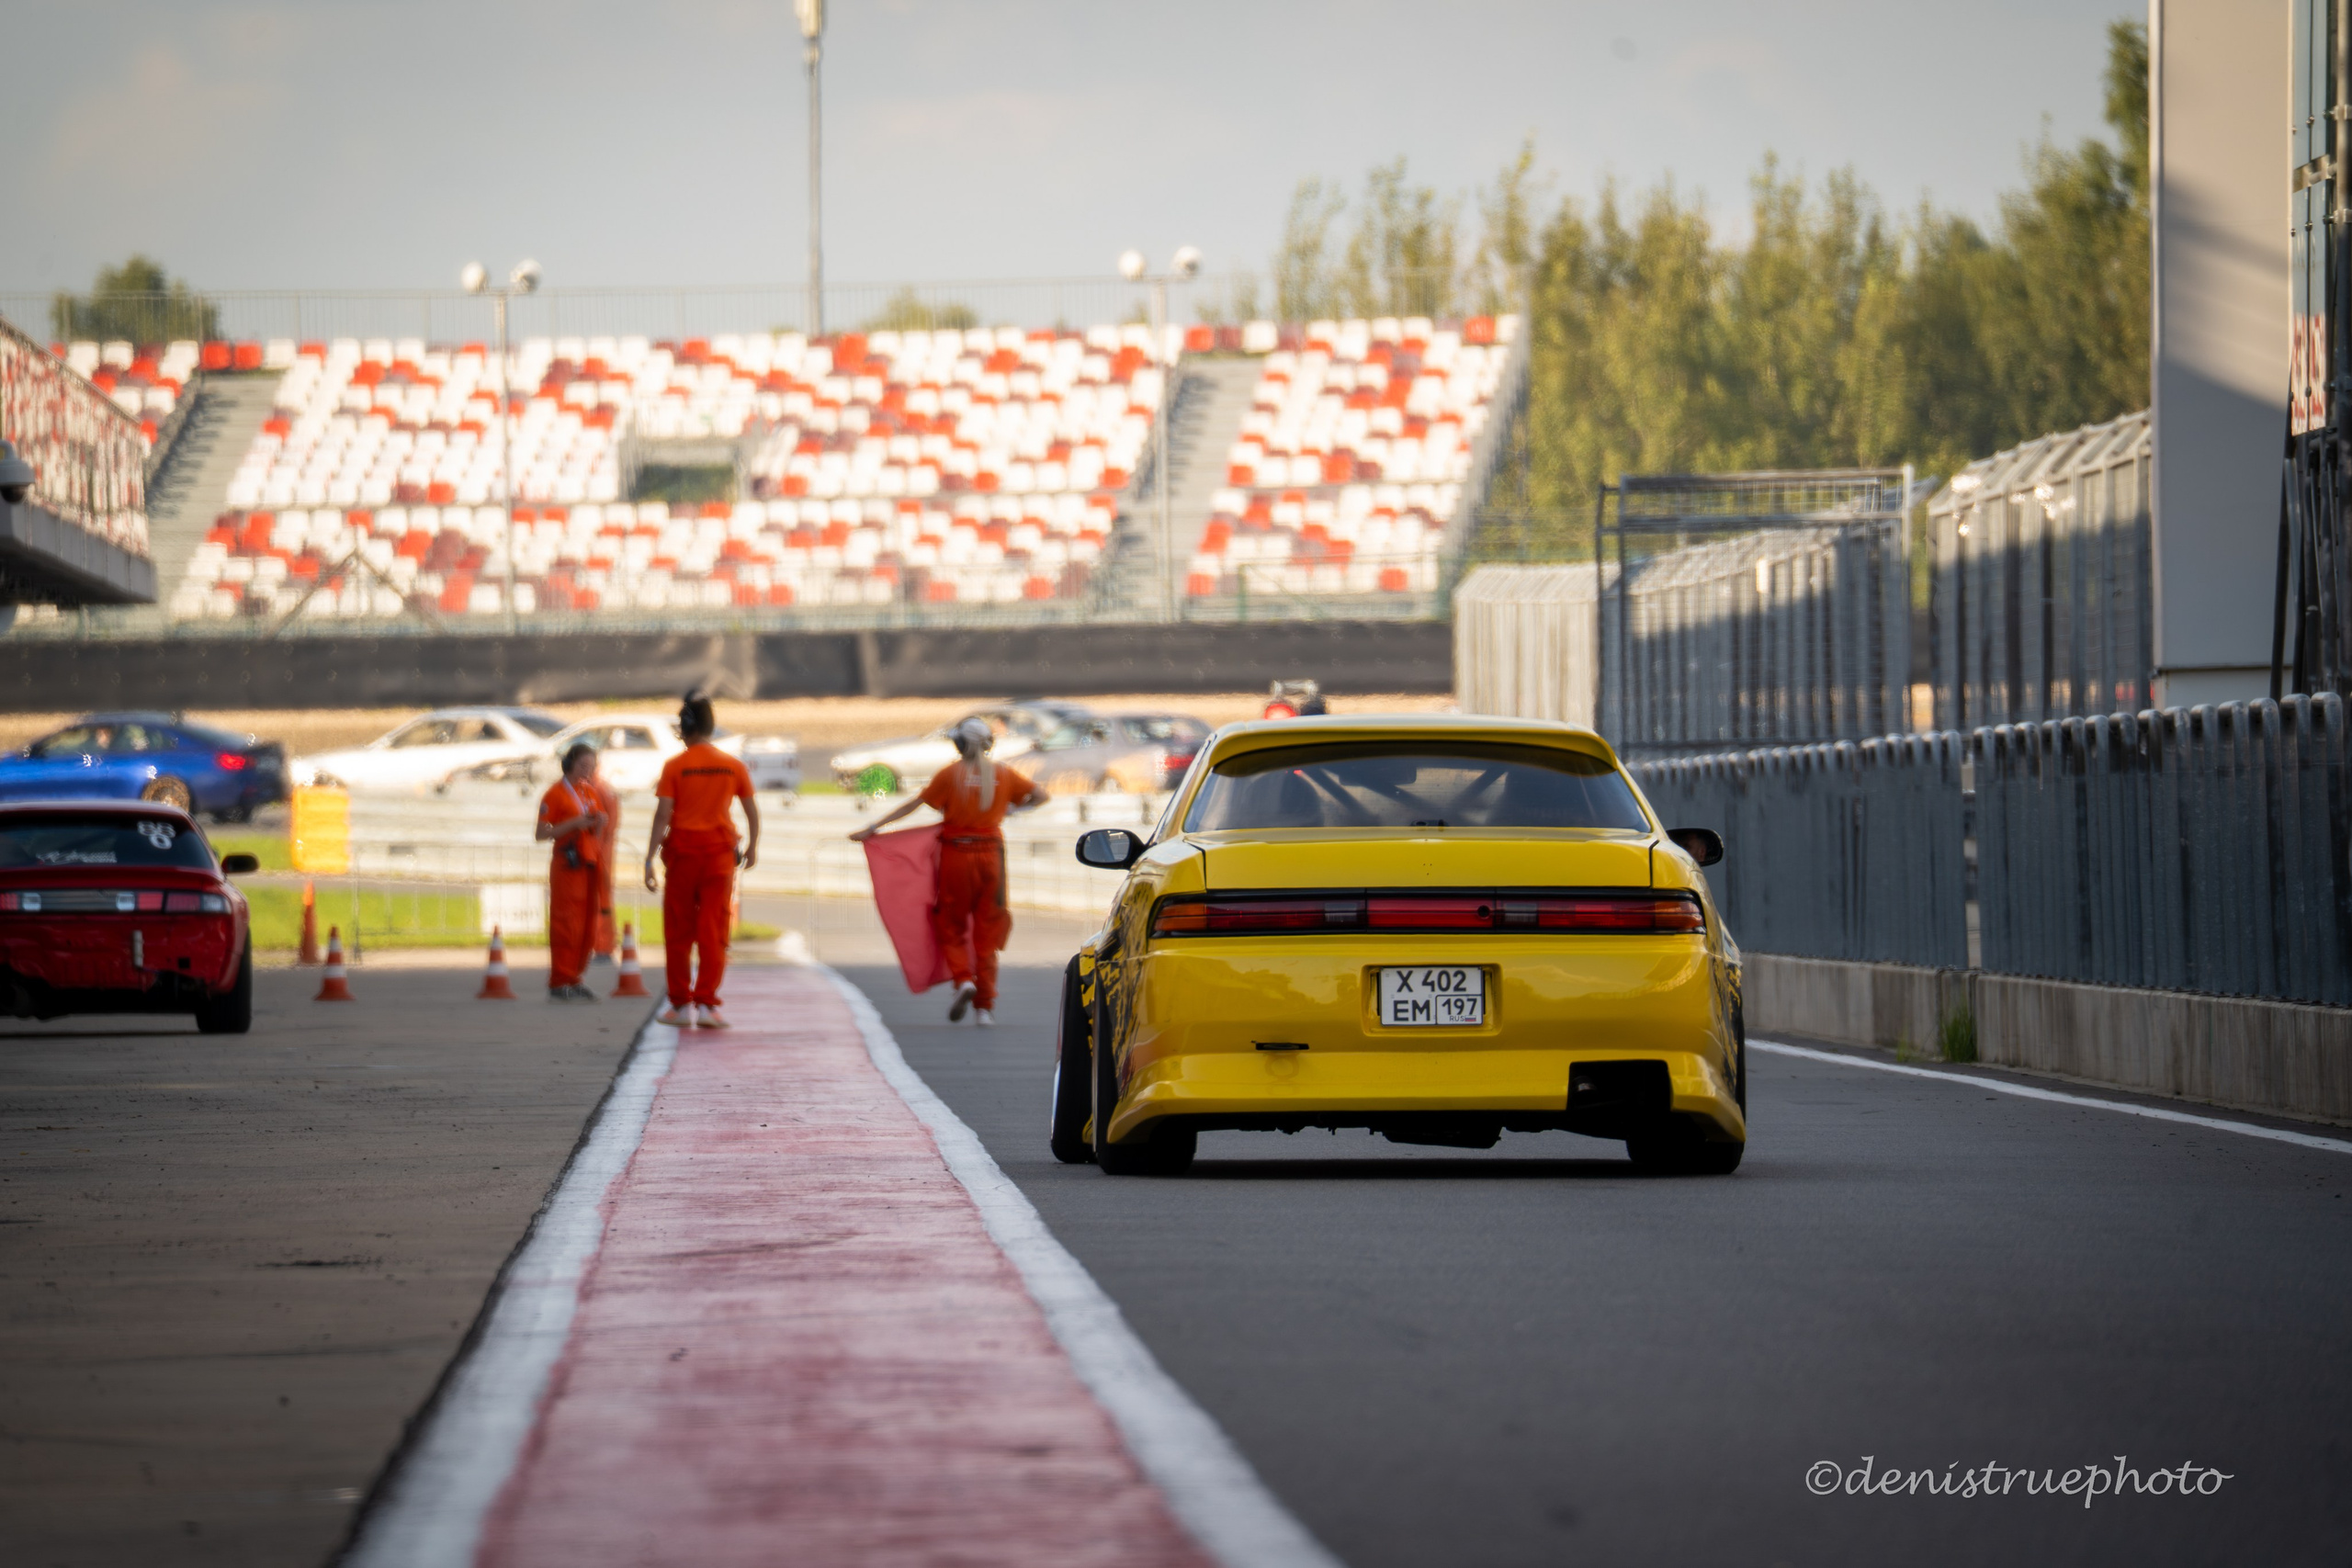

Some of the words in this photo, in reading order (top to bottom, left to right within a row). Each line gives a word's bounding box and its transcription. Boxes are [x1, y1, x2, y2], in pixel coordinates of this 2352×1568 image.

[1396, 970, 1413, 992] X
[1421, 970, 1466, 992] 402
[1393, 999, 1430, 1021] EM
[1442, 998, 1477, 1015] 197
